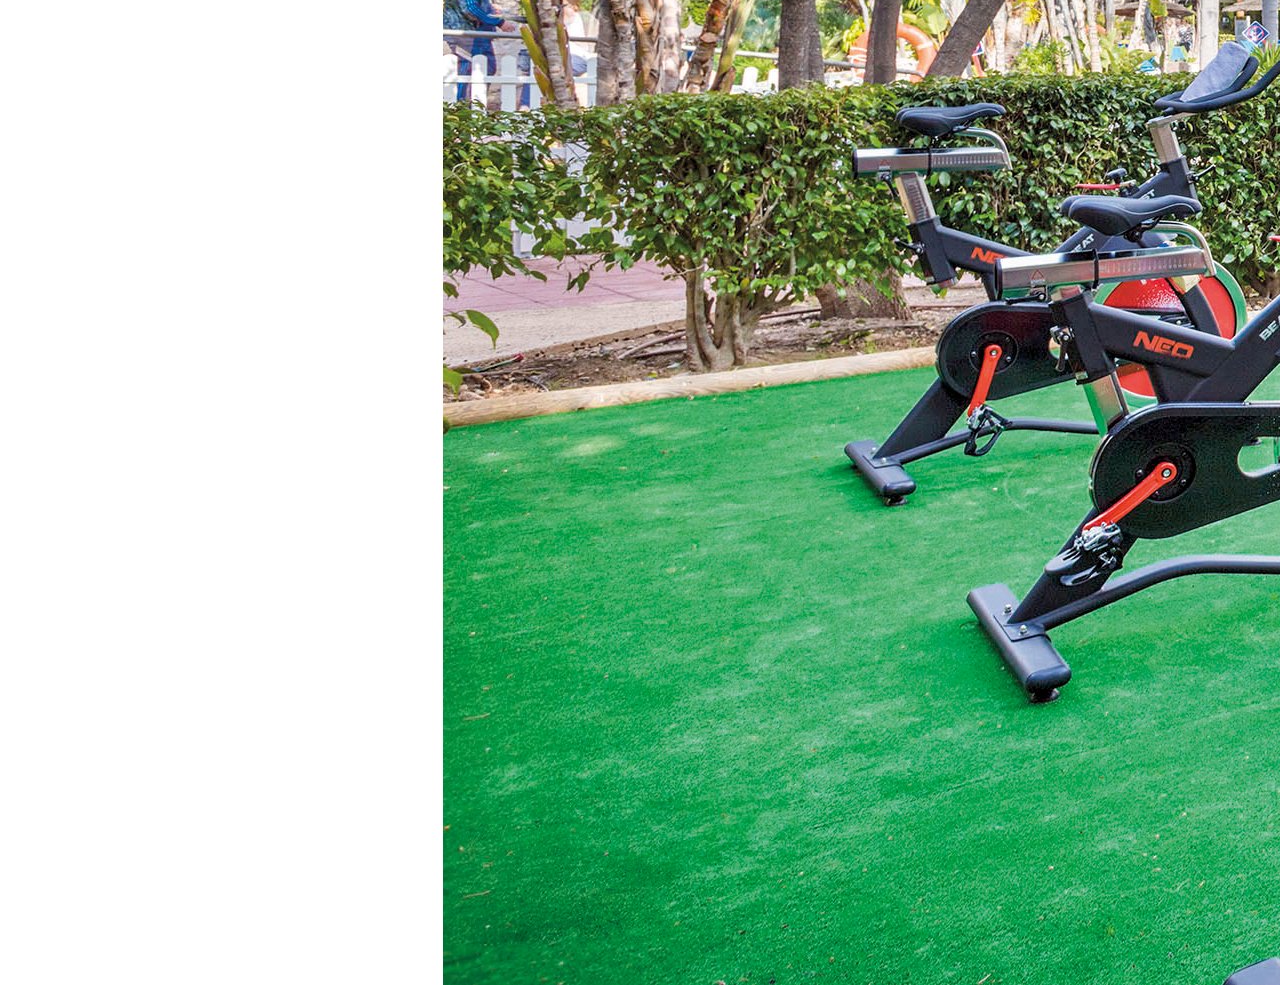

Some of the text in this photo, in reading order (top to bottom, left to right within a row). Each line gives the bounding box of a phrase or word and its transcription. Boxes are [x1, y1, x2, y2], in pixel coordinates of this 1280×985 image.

[1072, 234, 1095, 253] EAT
[970, 247, 1008, 264] NE
[1133, 330, 1194, 359] NEO
